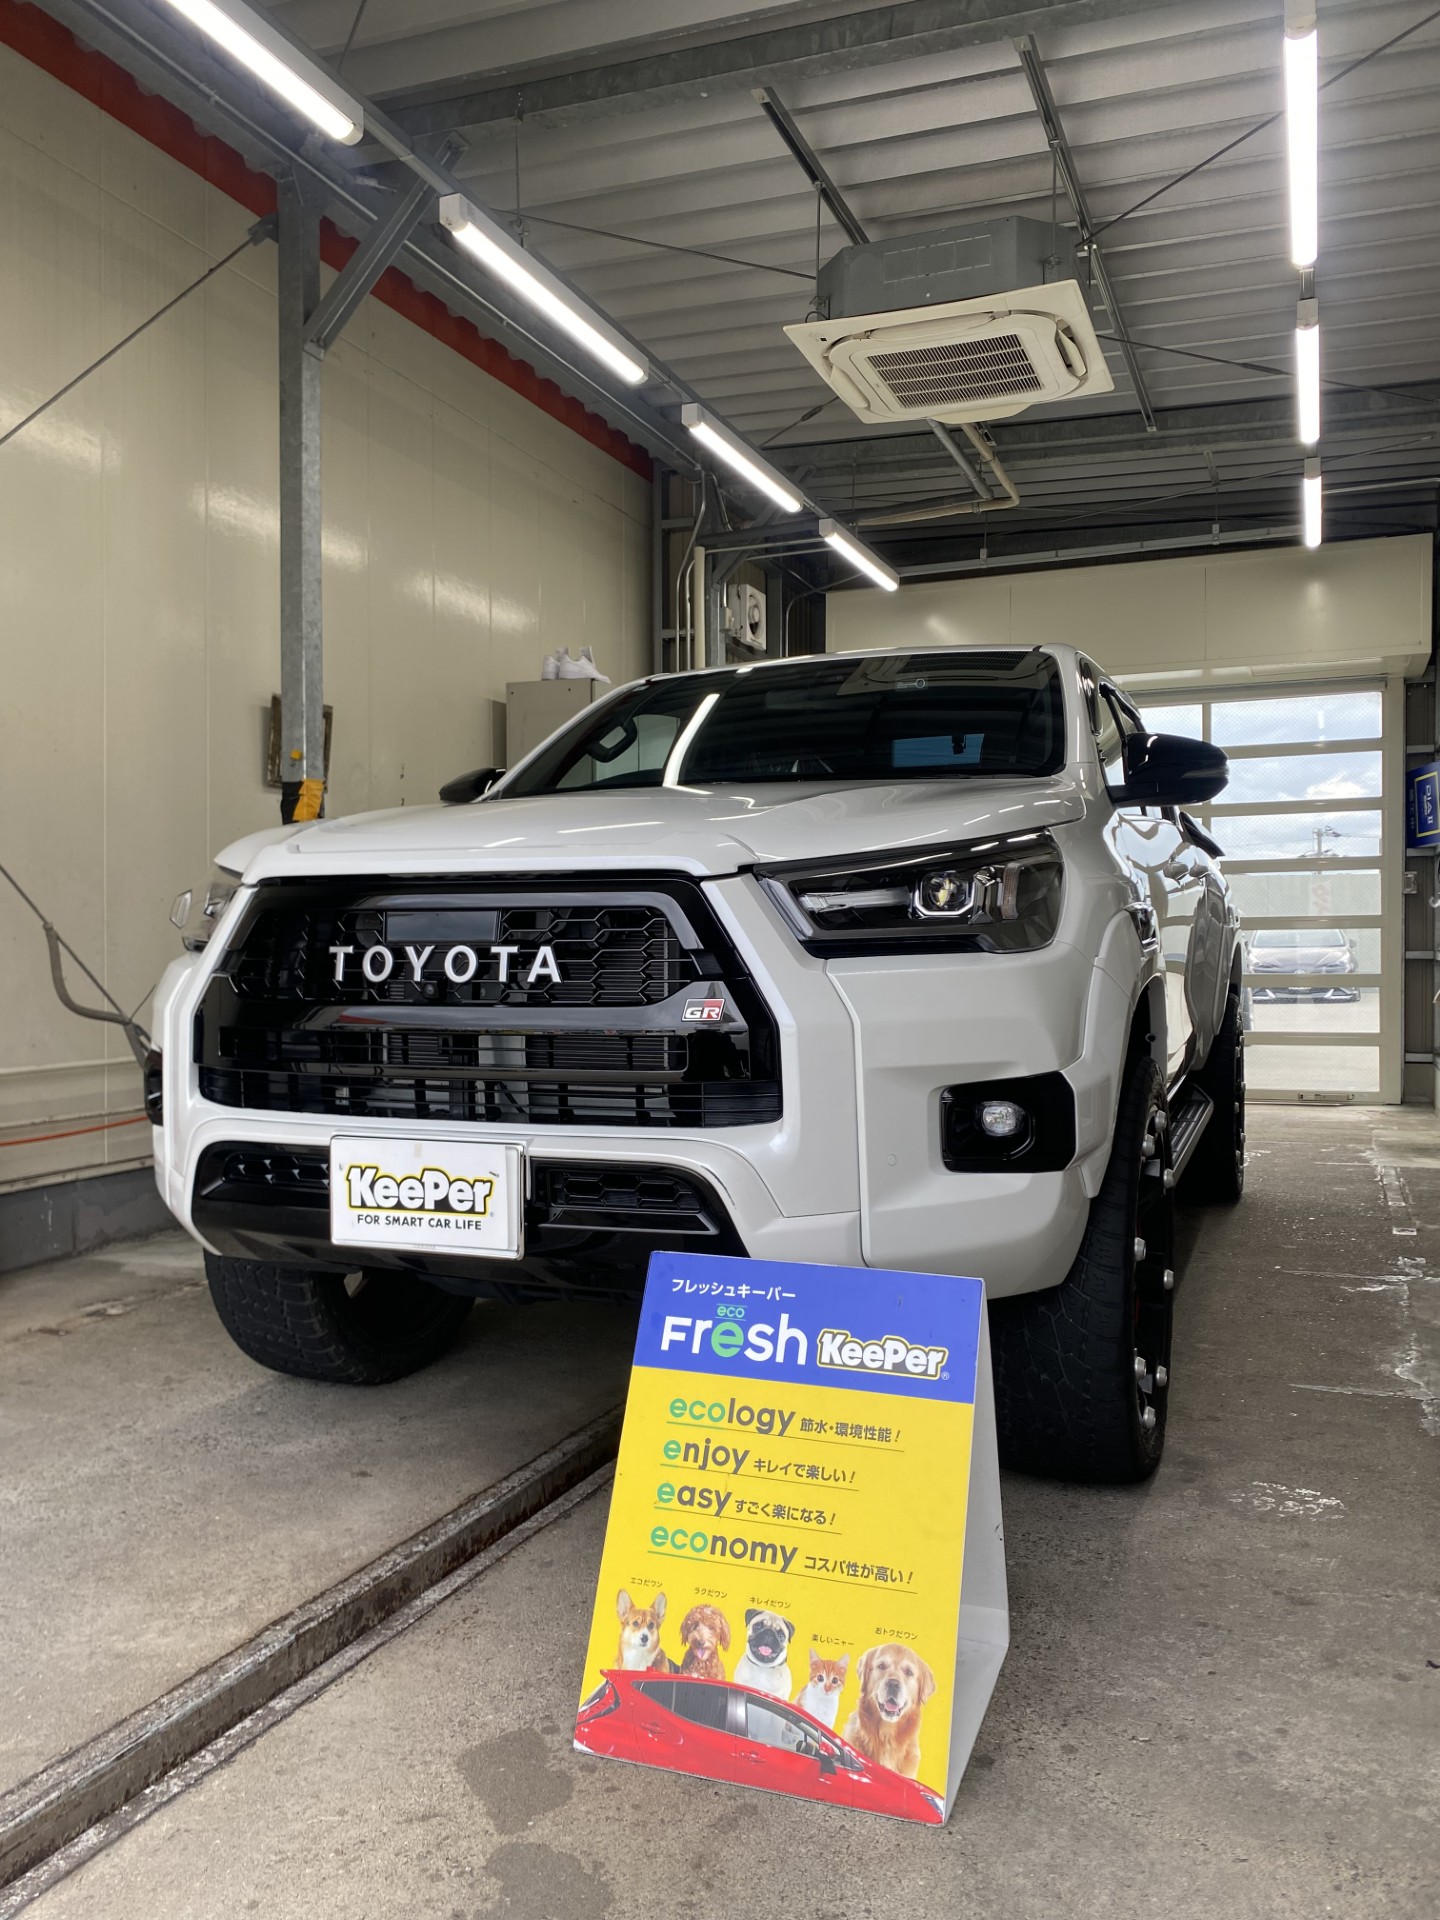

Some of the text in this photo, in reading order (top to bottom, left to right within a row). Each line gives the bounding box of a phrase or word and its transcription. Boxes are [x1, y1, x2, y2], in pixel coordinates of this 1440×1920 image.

[329, 944, 562, 983] TOYOTA
[684, 1005, 721, 1020] GR
[347, 1165, 493, 1214] KeePer
[357, 1214, 482, 1230] FOR SMART CAR LIFE
[671, 1278, 796, 1301] フレッシュキーパー
[716, 1304, 745, 1318] eco
[660, 1312, 808, 1366] Fresh
[669, 1397, 796, 1434] ecology
[663, 1437, 856, 1484] enjoy キレイで楽しい！
[657, 1482, 836, 1526] easy すごく楽になる！
[650, 1525, 915, 1585] economy コスパ性が高い！
[630, 1577, 663, 1588] エコだワン
[694, 1587, 728, 1599] ラクだワン
[749, 1597, 791, 1609] キレイだワン
[875, 1627, 918, 1641] おトクだワン
